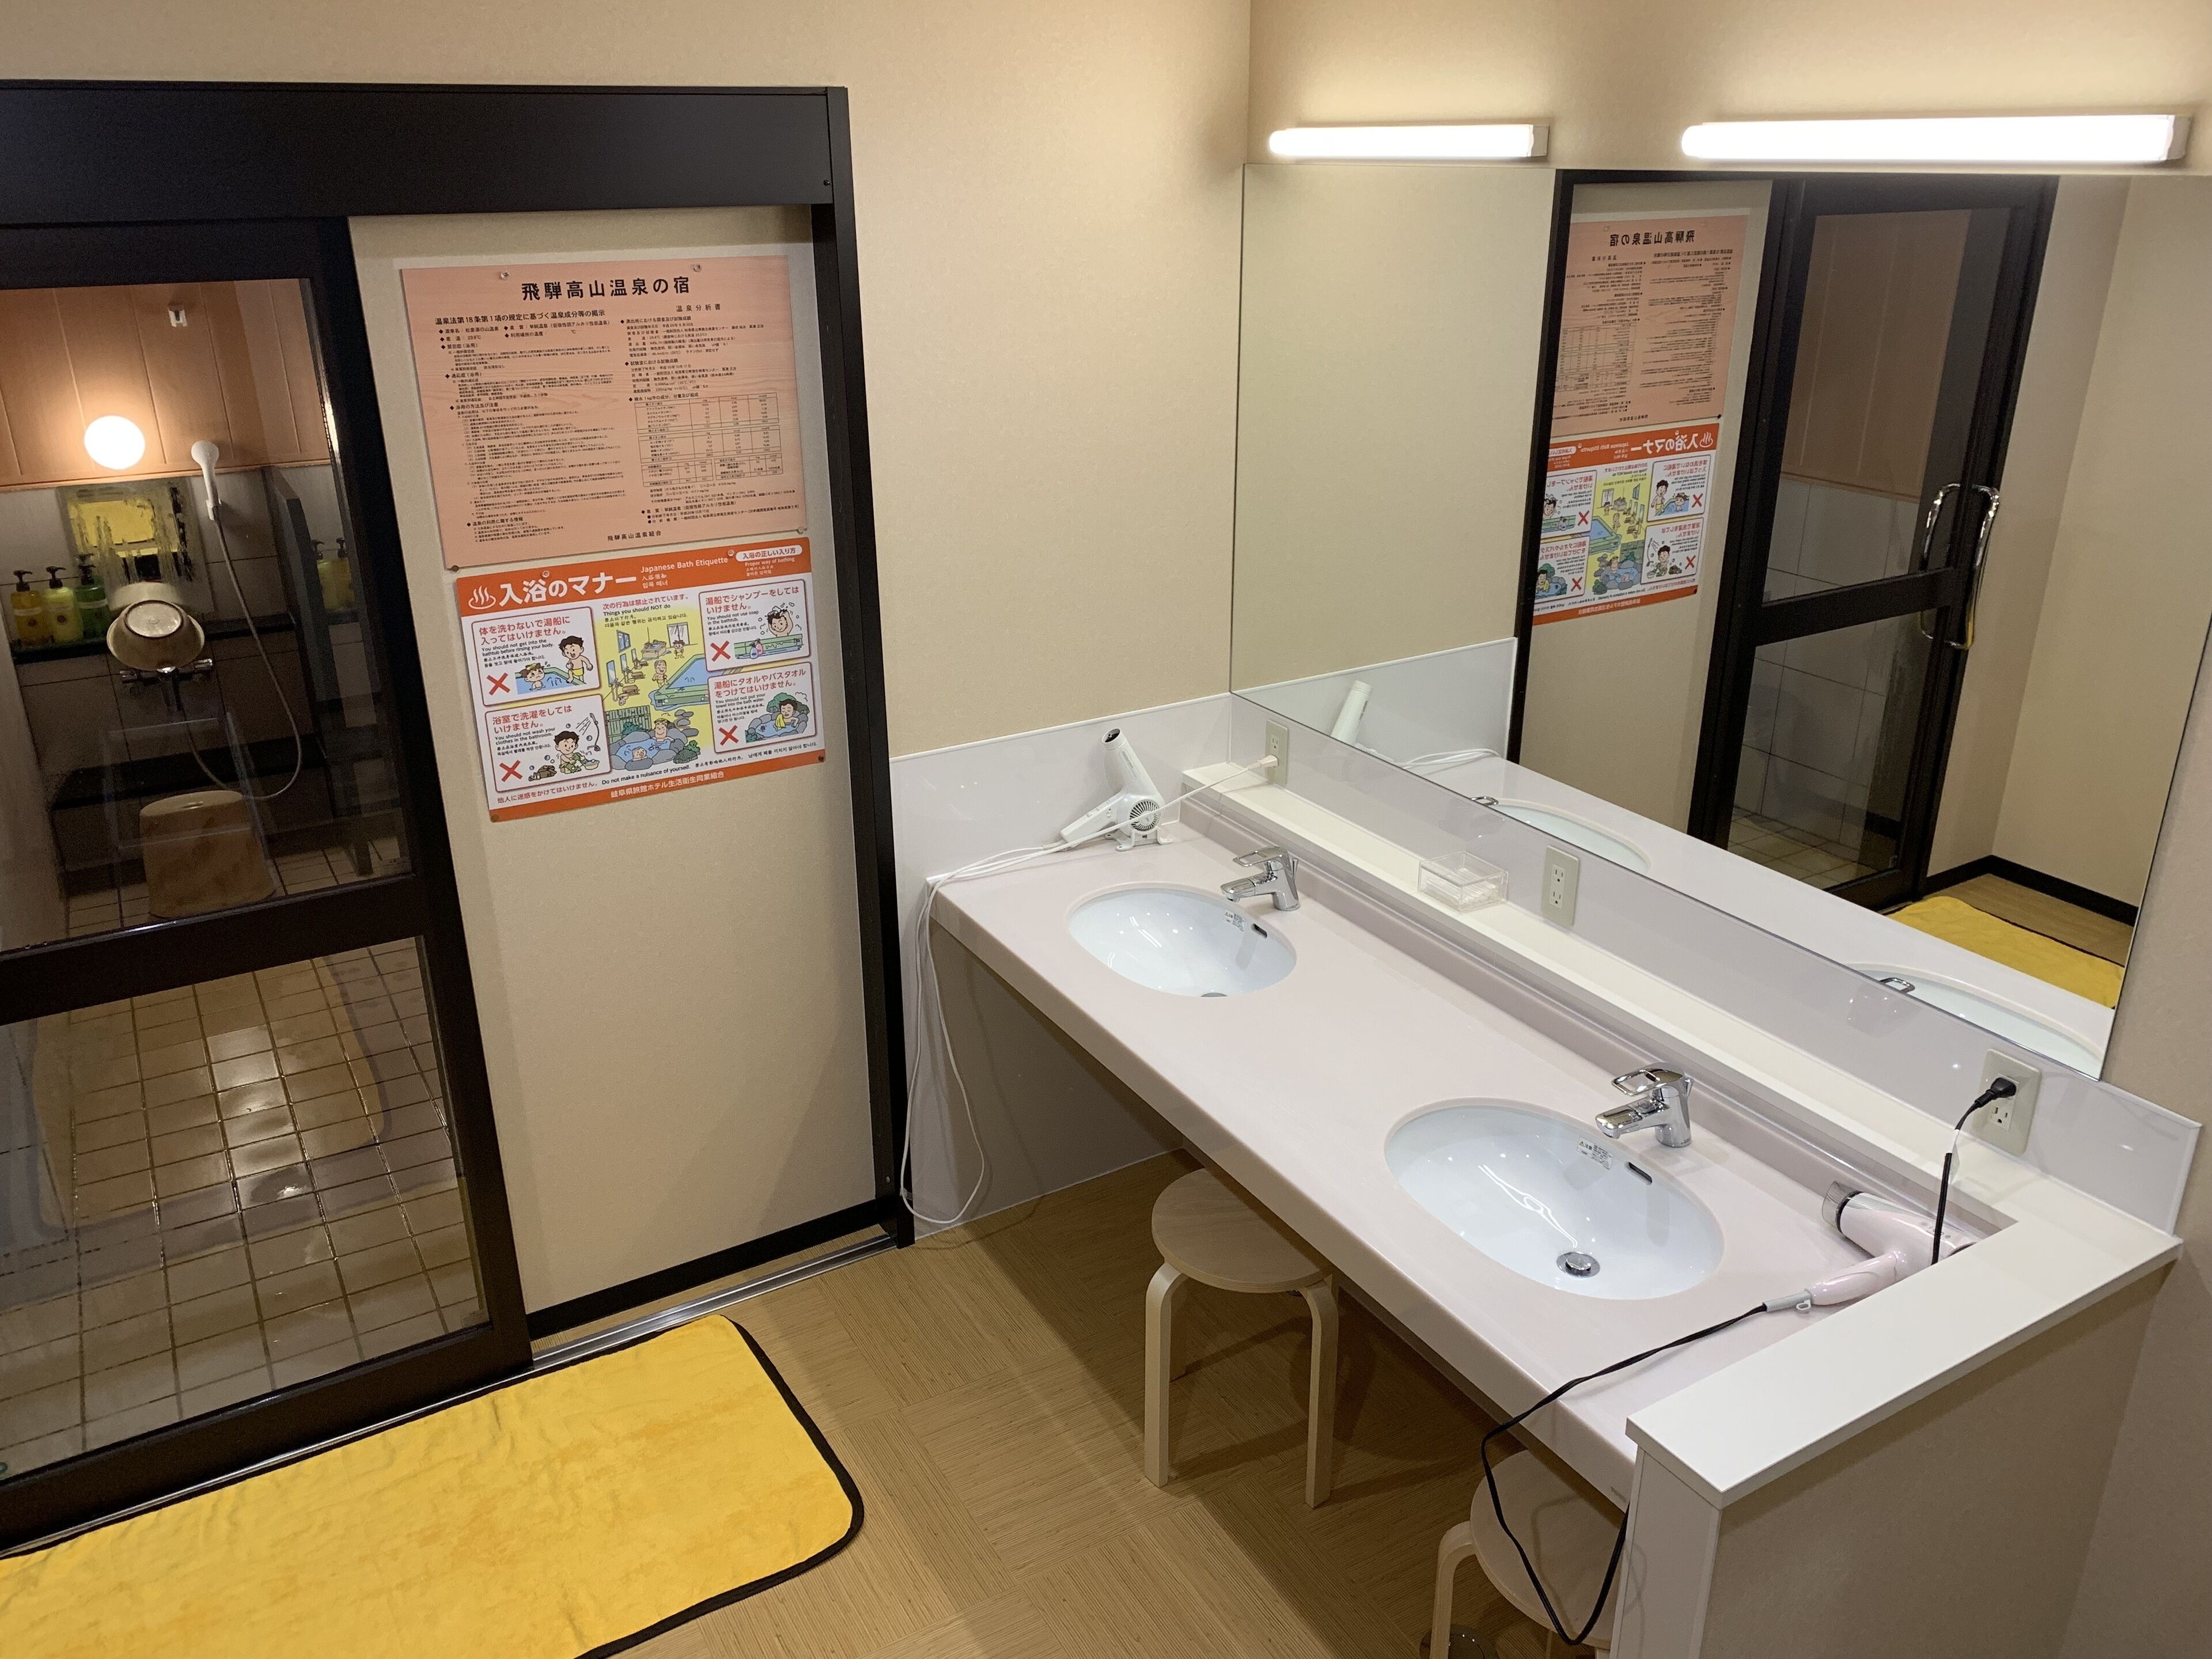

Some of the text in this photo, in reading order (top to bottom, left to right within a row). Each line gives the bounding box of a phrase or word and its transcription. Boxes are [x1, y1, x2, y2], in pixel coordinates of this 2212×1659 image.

[522, 276, 688, 300] 飛騨高山温泉の宿
[608, 531, 661, 541] 飛騨高山温泉組合
[743, 548, 795, 559] 入浴の正しい入り方
[641, 564, 675, 573] Japanese
[695, 558, 728, 566] Etiquette
[500, 572, 636, 606] 入浴のマナー
[706, 586, 798, 605] 湯船でシャンプーをしては
[603, 594, 687, 609] 次の行為は禁止されています。
[707, 603, 750, 613] いけません。
[479, 616, 570, 635] 体を洗わないで湯船に
[482, 627, 565, 645] 入ってはいけません。
[714, 669, 805, 689] 湯船にタオルやバスタオル
[715, 680, 795, 698] をつけてはいけません。
[493, 705, 571, 725] 浴室で洗濯をしては
[494, 721, 542, 733] いけません。
[498, 782, 596, 803] 他人に迷惑をかけてはいけません。
[611, 771, 724, 797] 岐阜県旅館ホテル生活衛生同業組合
